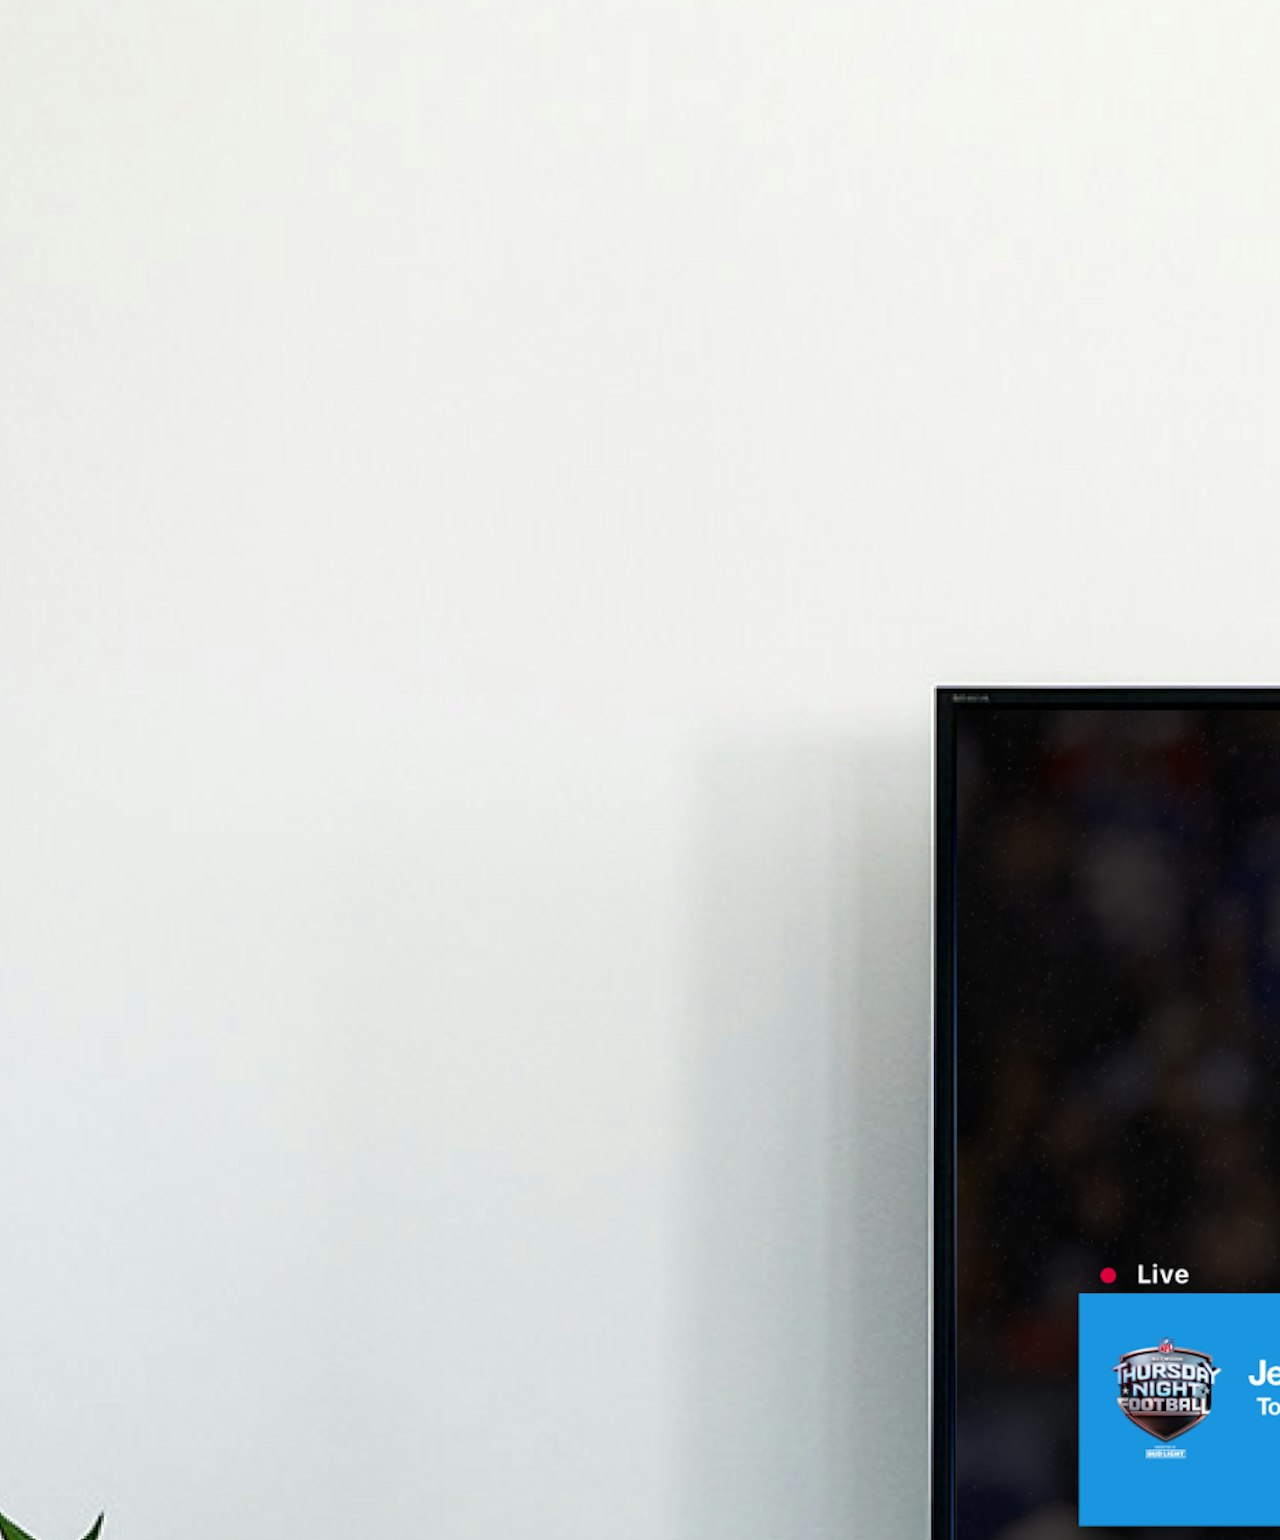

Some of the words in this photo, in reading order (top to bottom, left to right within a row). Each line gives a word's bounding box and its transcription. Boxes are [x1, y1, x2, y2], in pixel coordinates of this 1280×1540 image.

[1139, 1264, 1189, 1284] Live
[1113, 1361, 1222, 1384] THURSDAY
[1132, 1380, 1199, 1397] NIGHT
[1117, 1397, 1211, 1415] FOOTBALL
